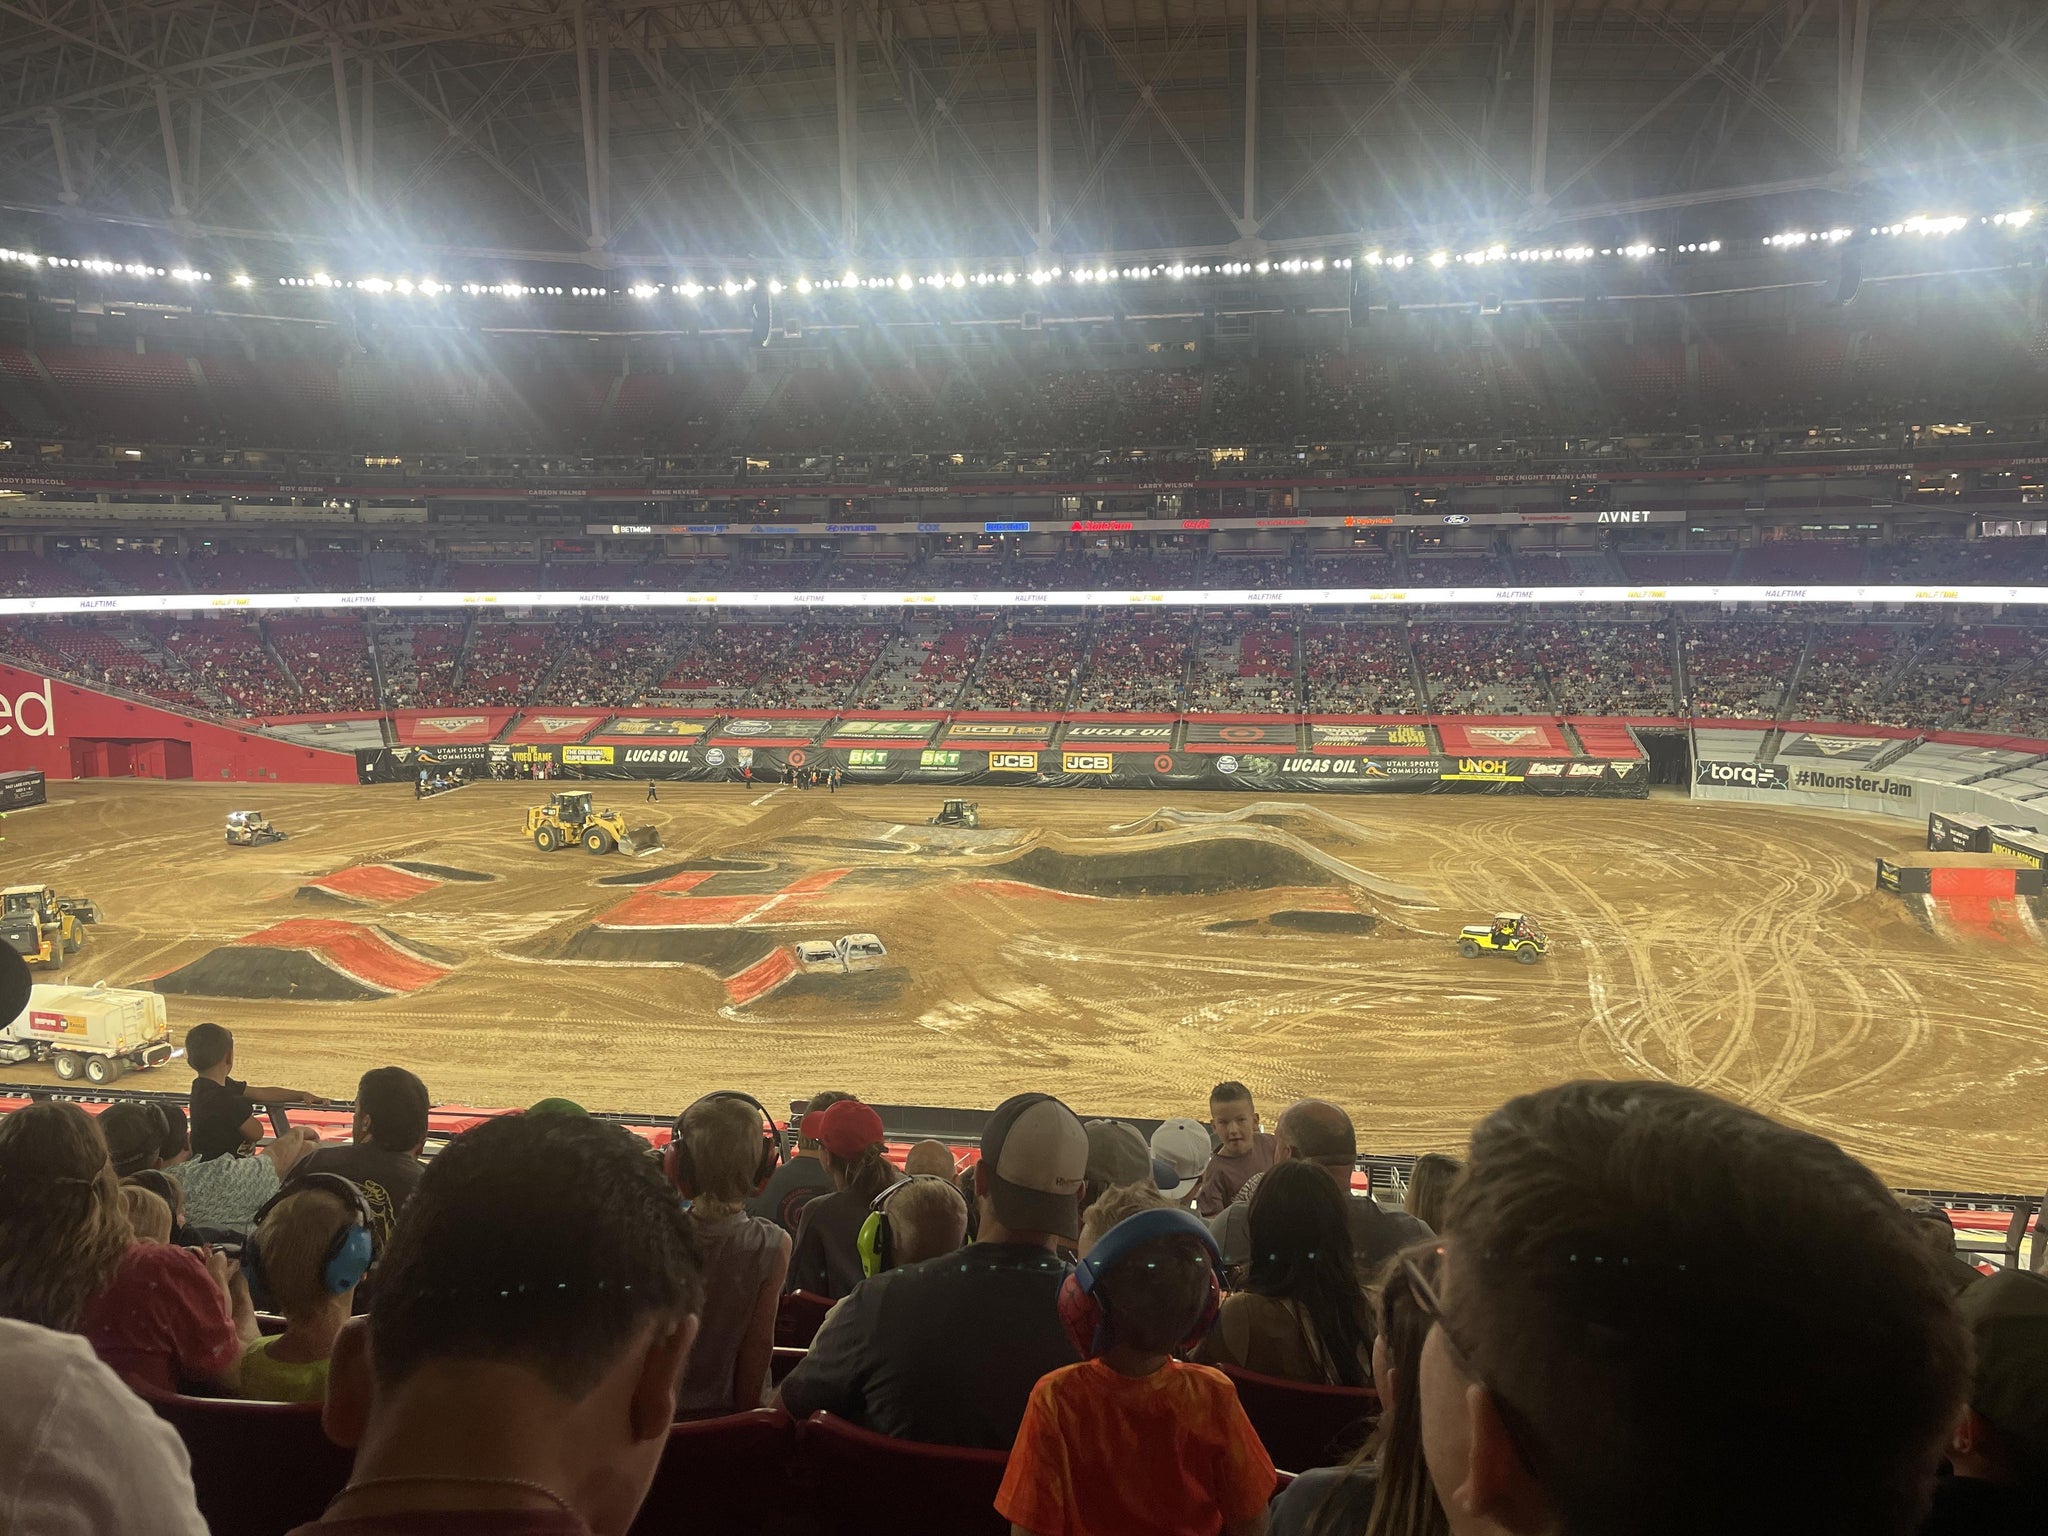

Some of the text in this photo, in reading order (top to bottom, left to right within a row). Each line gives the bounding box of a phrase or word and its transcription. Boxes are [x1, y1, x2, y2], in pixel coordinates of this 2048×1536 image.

[26, 478, 65, 486] DRISCOLL
[916, 523, 940, 532] COX
[1068, 728, 1137, 736] LUCAS
[512, 752, 532, 762] VIDEO
[532, 752, 552, 762] GAME
[625, 750, 666, 762] LUCAS
[849, 750, 888, 764] BKT
[921, 752, 960, 765] BKT
[993, 755, 1034, 767] JCB
[1066, 756, 1108, 769] JCB
[1282, 758, 1331, 772] LUCAS
[1458, 757, 1506, 774] UNOH
[1795, 770, 1912, 798] #MonsterJam
